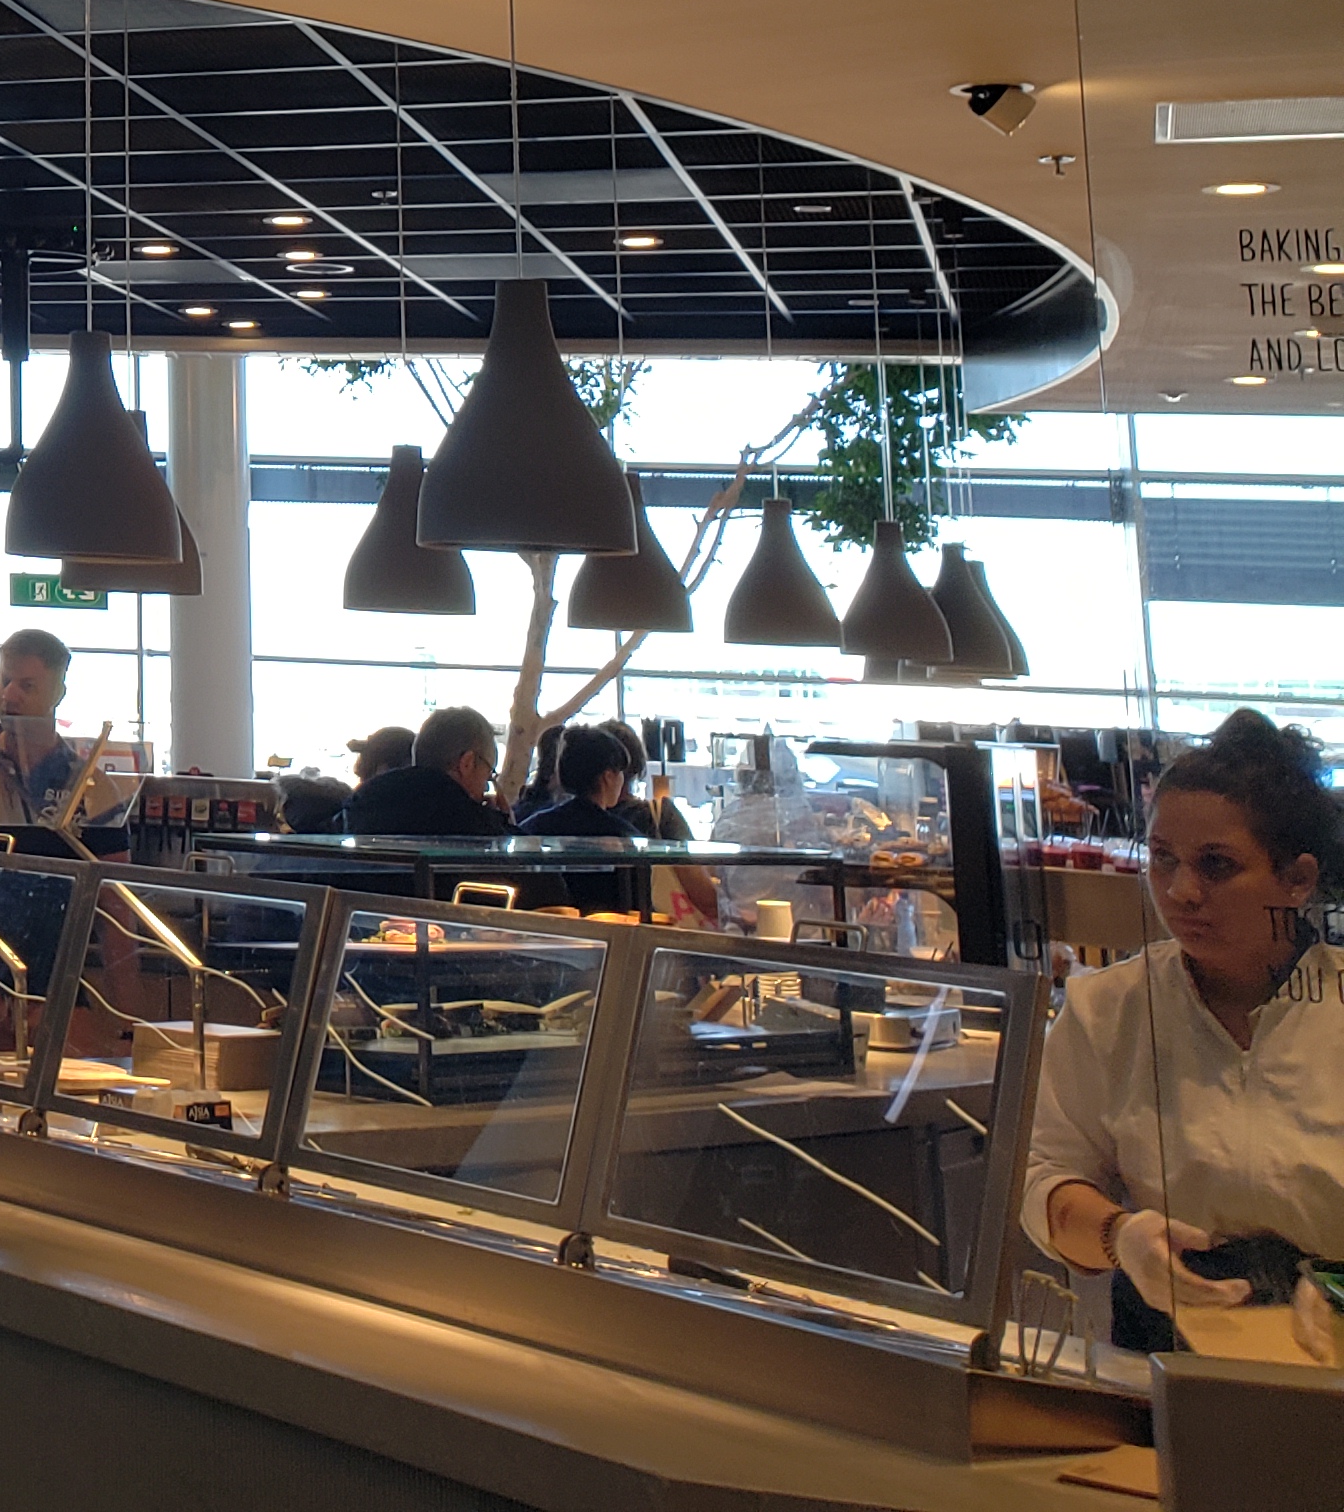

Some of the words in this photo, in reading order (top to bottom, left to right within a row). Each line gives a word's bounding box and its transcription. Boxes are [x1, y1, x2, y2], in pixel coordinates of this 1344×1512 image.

[1238, 228, 1342, 262] BAKING
[1240, 282, 1296, 317] THE
[1249, 338, 1303, 372] AND
